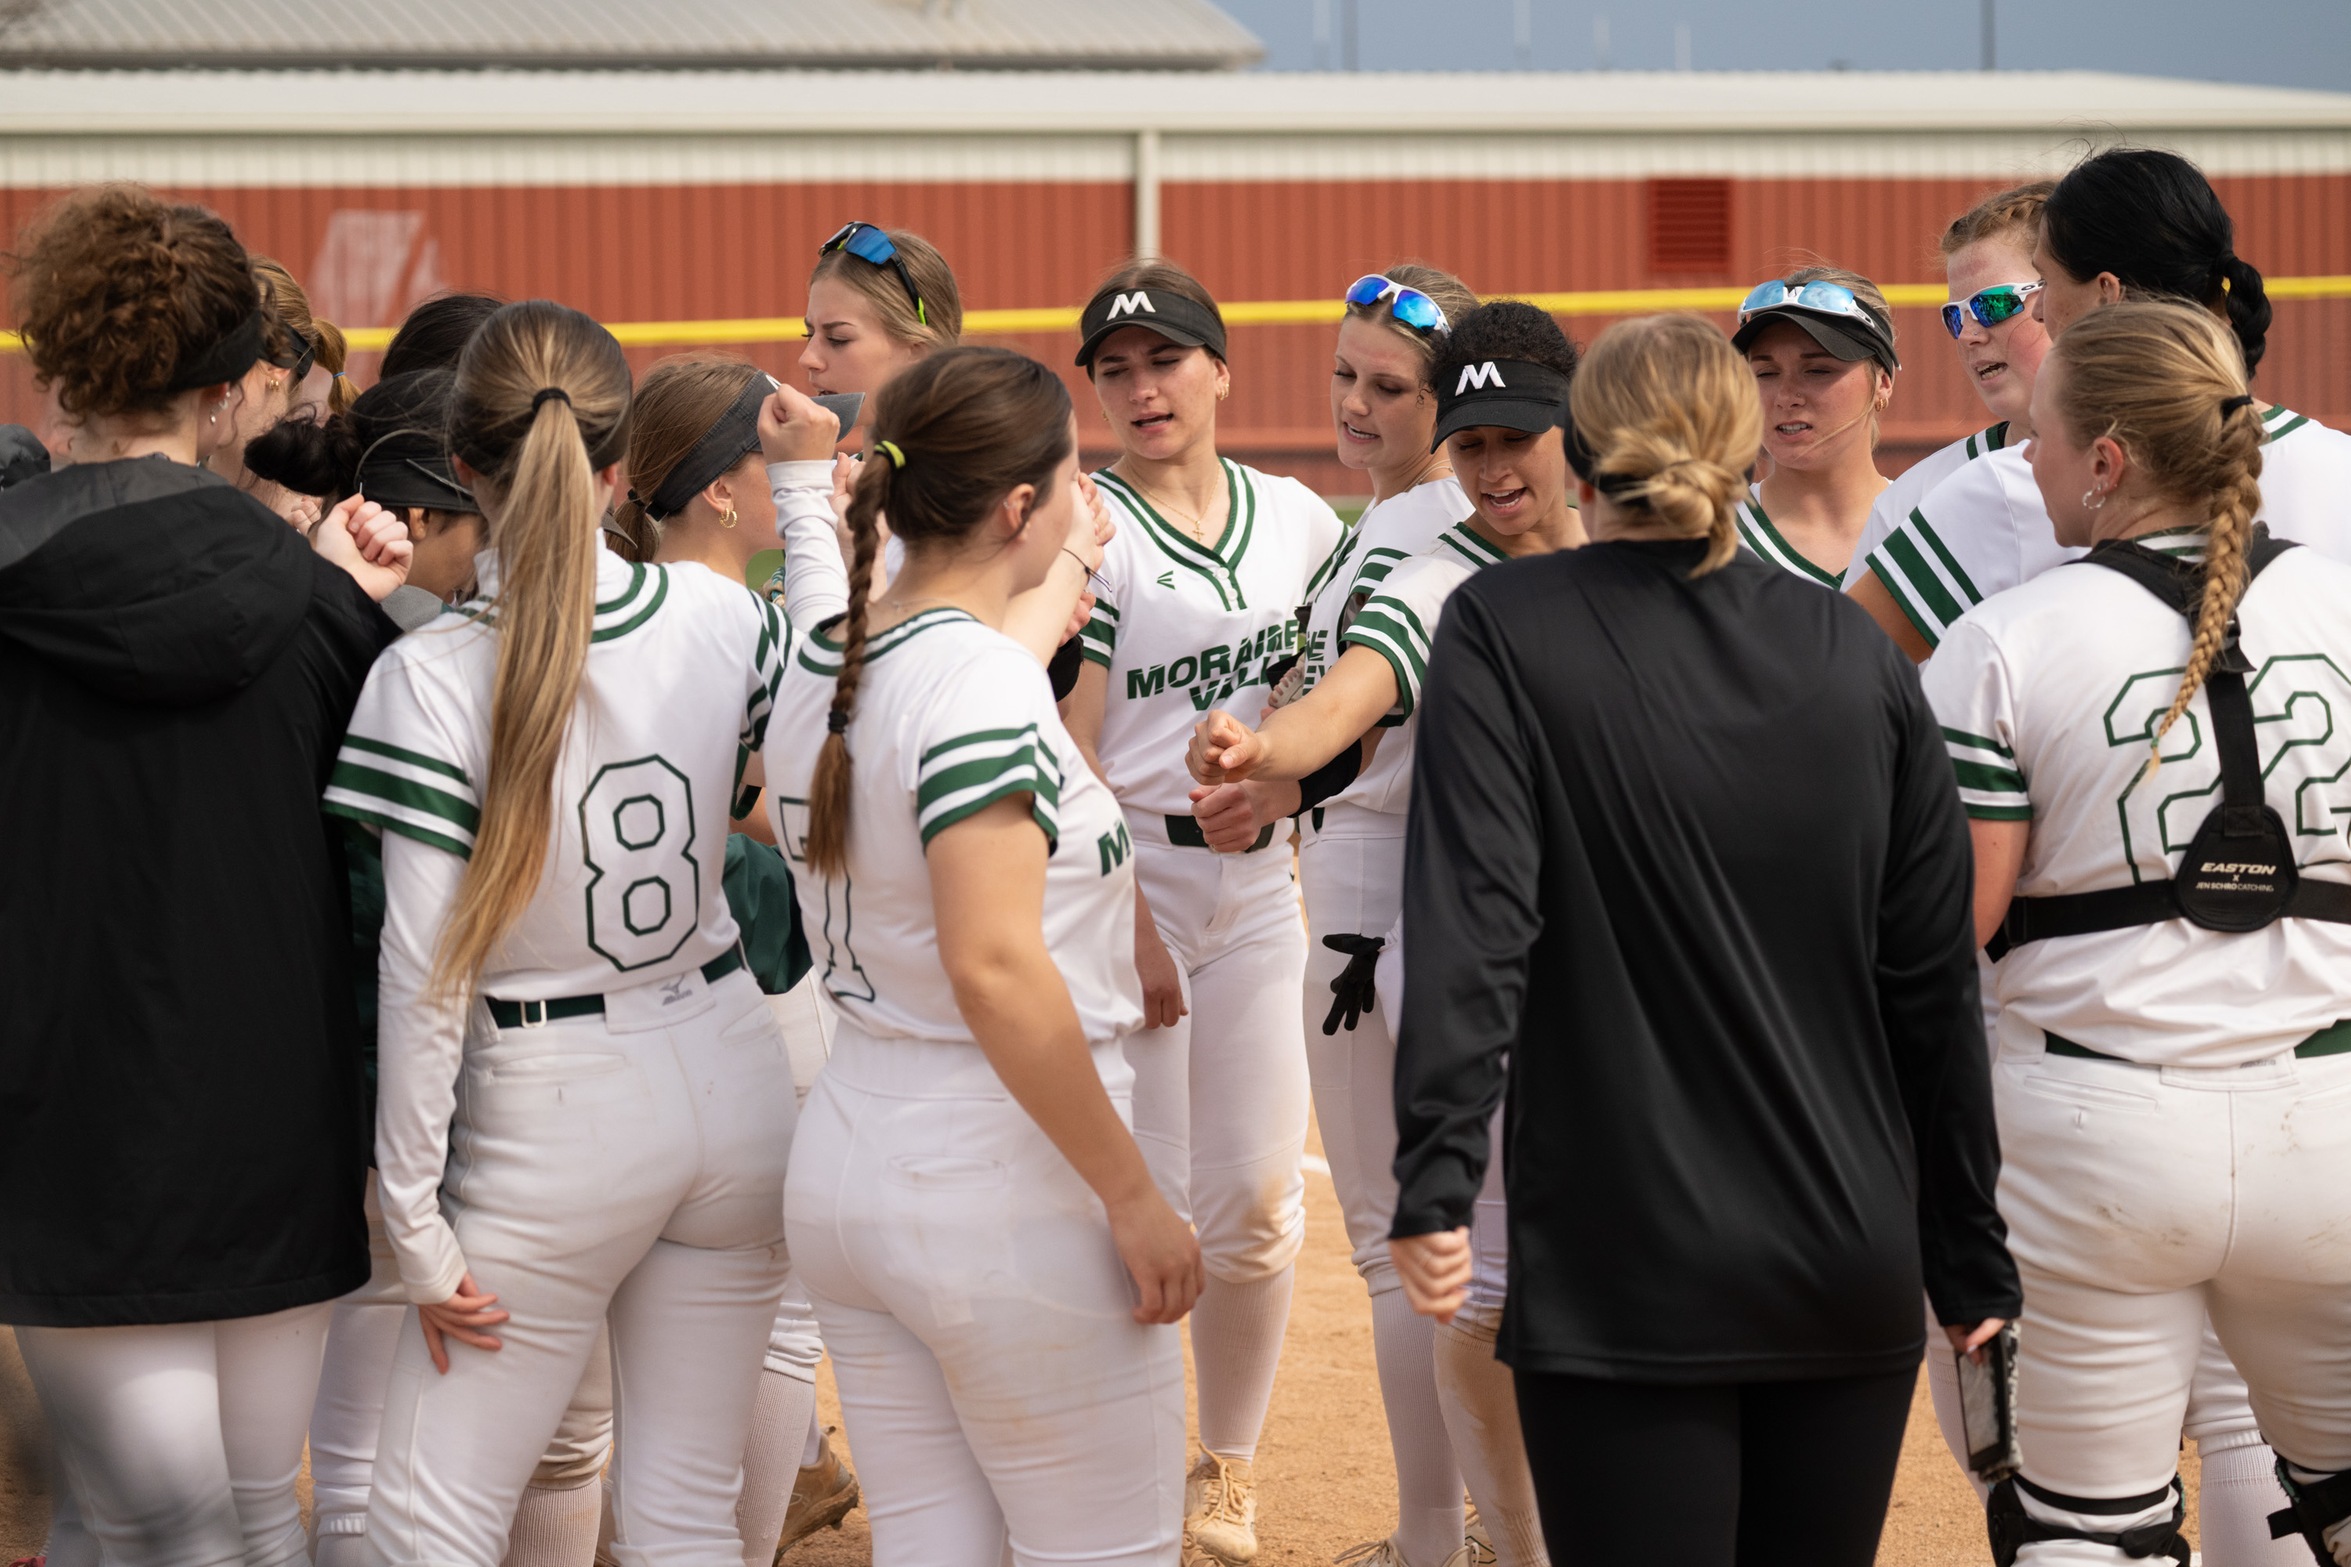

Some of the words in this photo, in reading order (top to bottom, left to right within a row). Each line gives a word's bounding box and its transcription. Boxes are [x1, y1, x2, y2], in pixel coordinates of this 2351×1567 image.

[1106, 291, 1156, 321] M
[1455, 361, 1506, 397] M
[2103, 653, 2351, 885] 22
[579, 754, 699, 972] 8
[2200, 862, 2276, 875] EASTON
[2237, 883, 2274, 892] CATCHING
